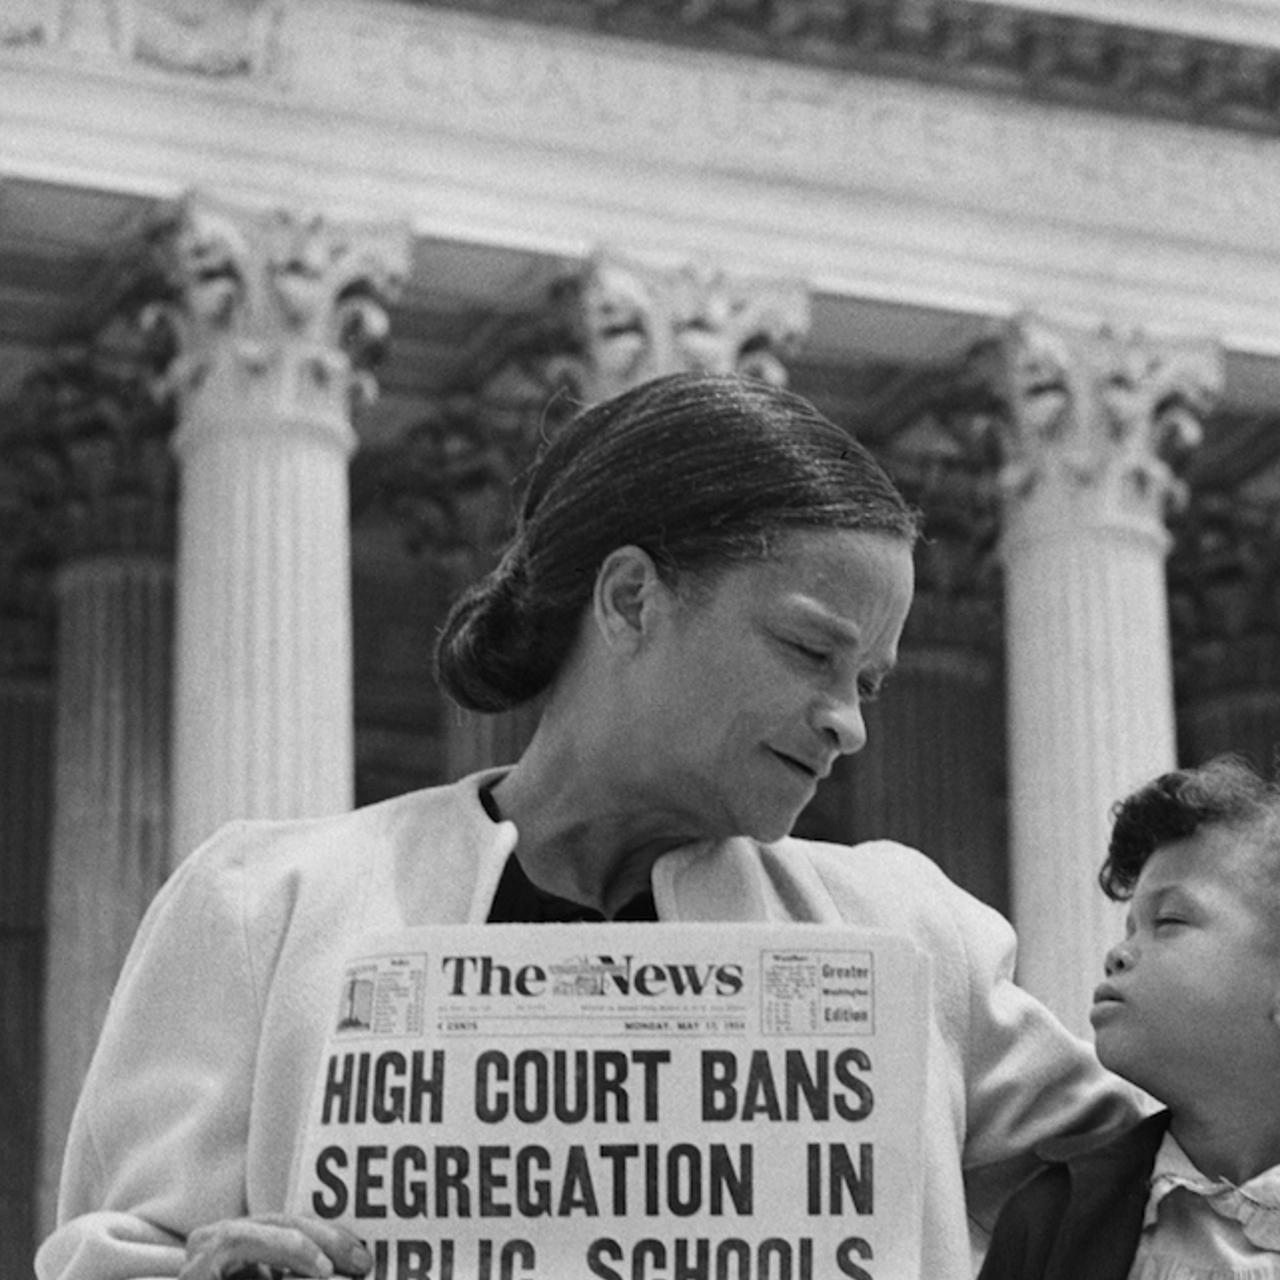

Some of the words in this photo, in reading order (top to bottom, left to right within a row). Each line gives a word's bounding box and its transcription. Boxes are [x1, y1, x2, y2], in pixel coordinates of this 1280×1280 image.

[441, 955, 546, 997] The
[597, 955, 743, 997] News
[822, 964, 869, 979] Greater
[677, 1021, 700, 1031] MAY
[824, 1007, 868, 1022] Edition
[321, 1050, 445, 1125] HIGH
[474, 1049, 673, 1125] COURT
[700, 1048, 874, 1123] BANS
[311, 1143, 754, 1220] SEGREGATION
[807, 1142, 874, 1217] IN
